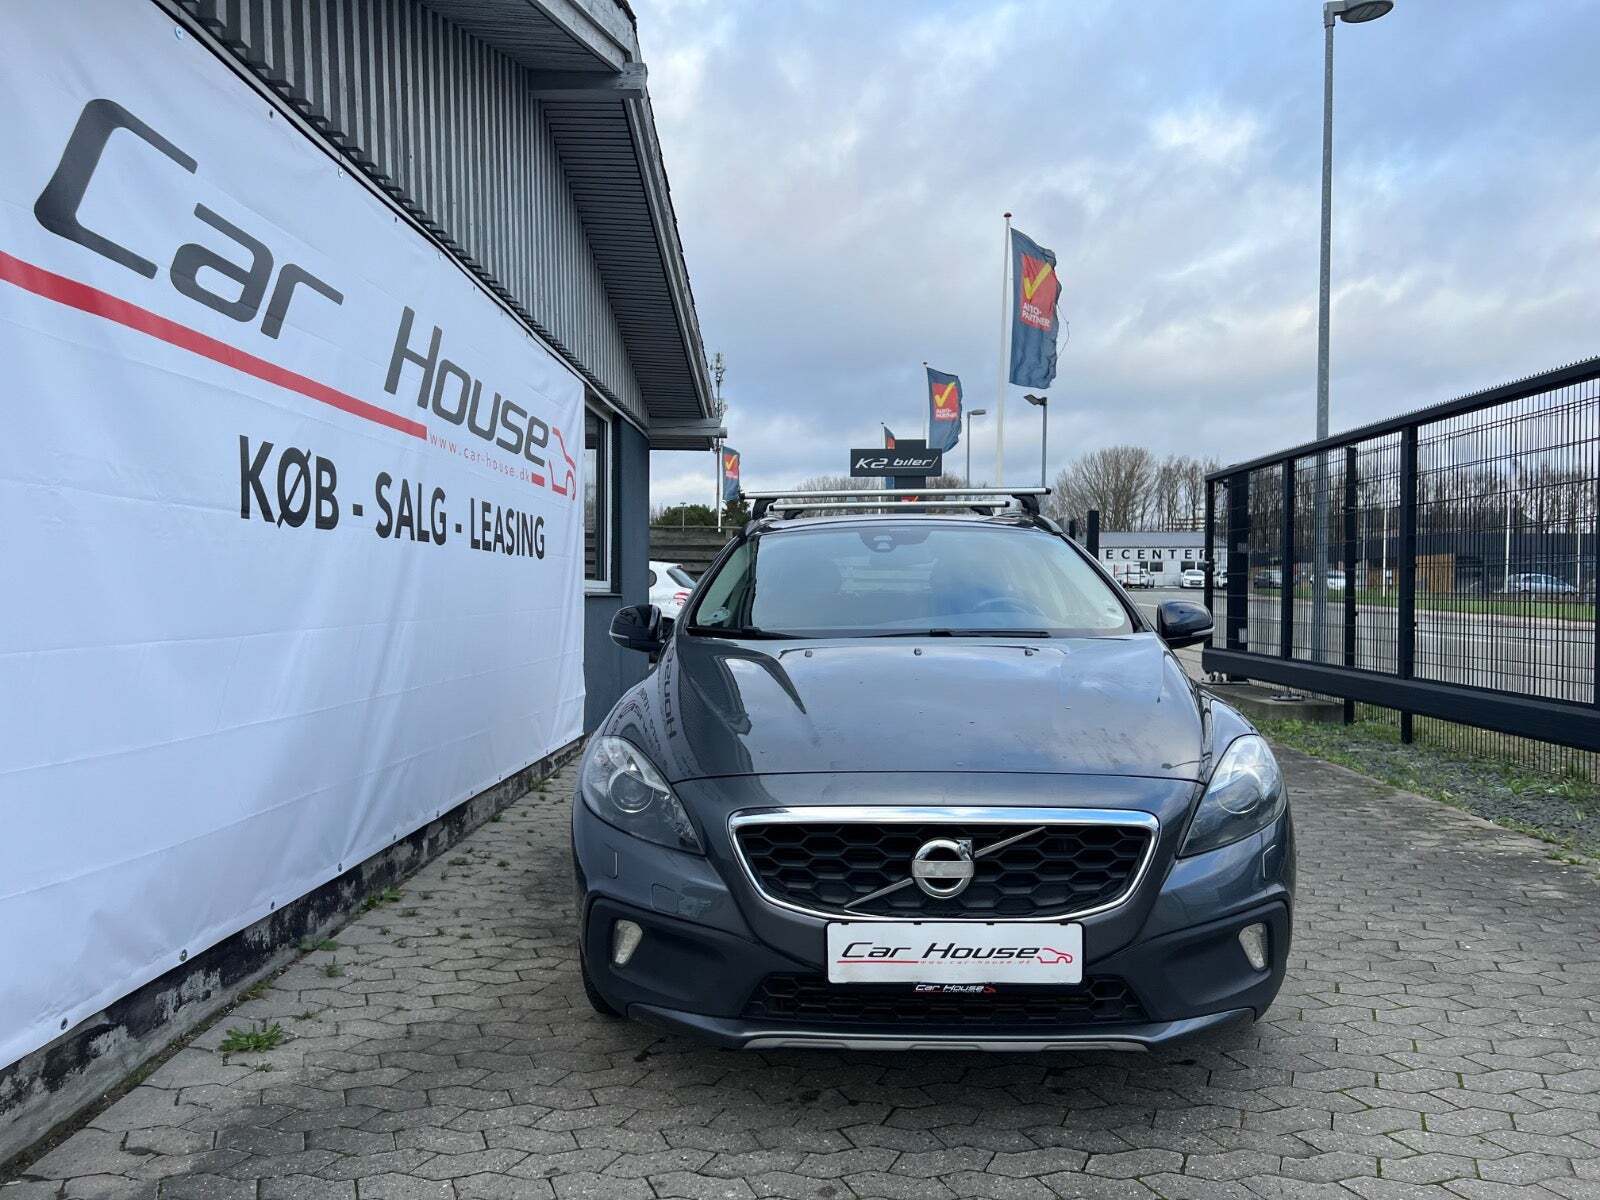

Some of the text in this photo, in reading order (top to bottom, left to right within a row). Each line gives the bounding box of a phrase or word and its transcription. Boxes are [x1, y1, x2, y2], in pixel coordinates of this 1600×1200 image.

[34, 98, 549, 467] Car House
[430, 434, 530, 482] www.car-house.dk
[855, 457, 932, 469] K2 biler
[239, 434, 339, 530] KØB
[375, 471, 447, 546] SALG
[470, 497, 545, 560] LEASING
[842, 942, 1040, 959] Car House
[914, 984, 984, 992] Car House
